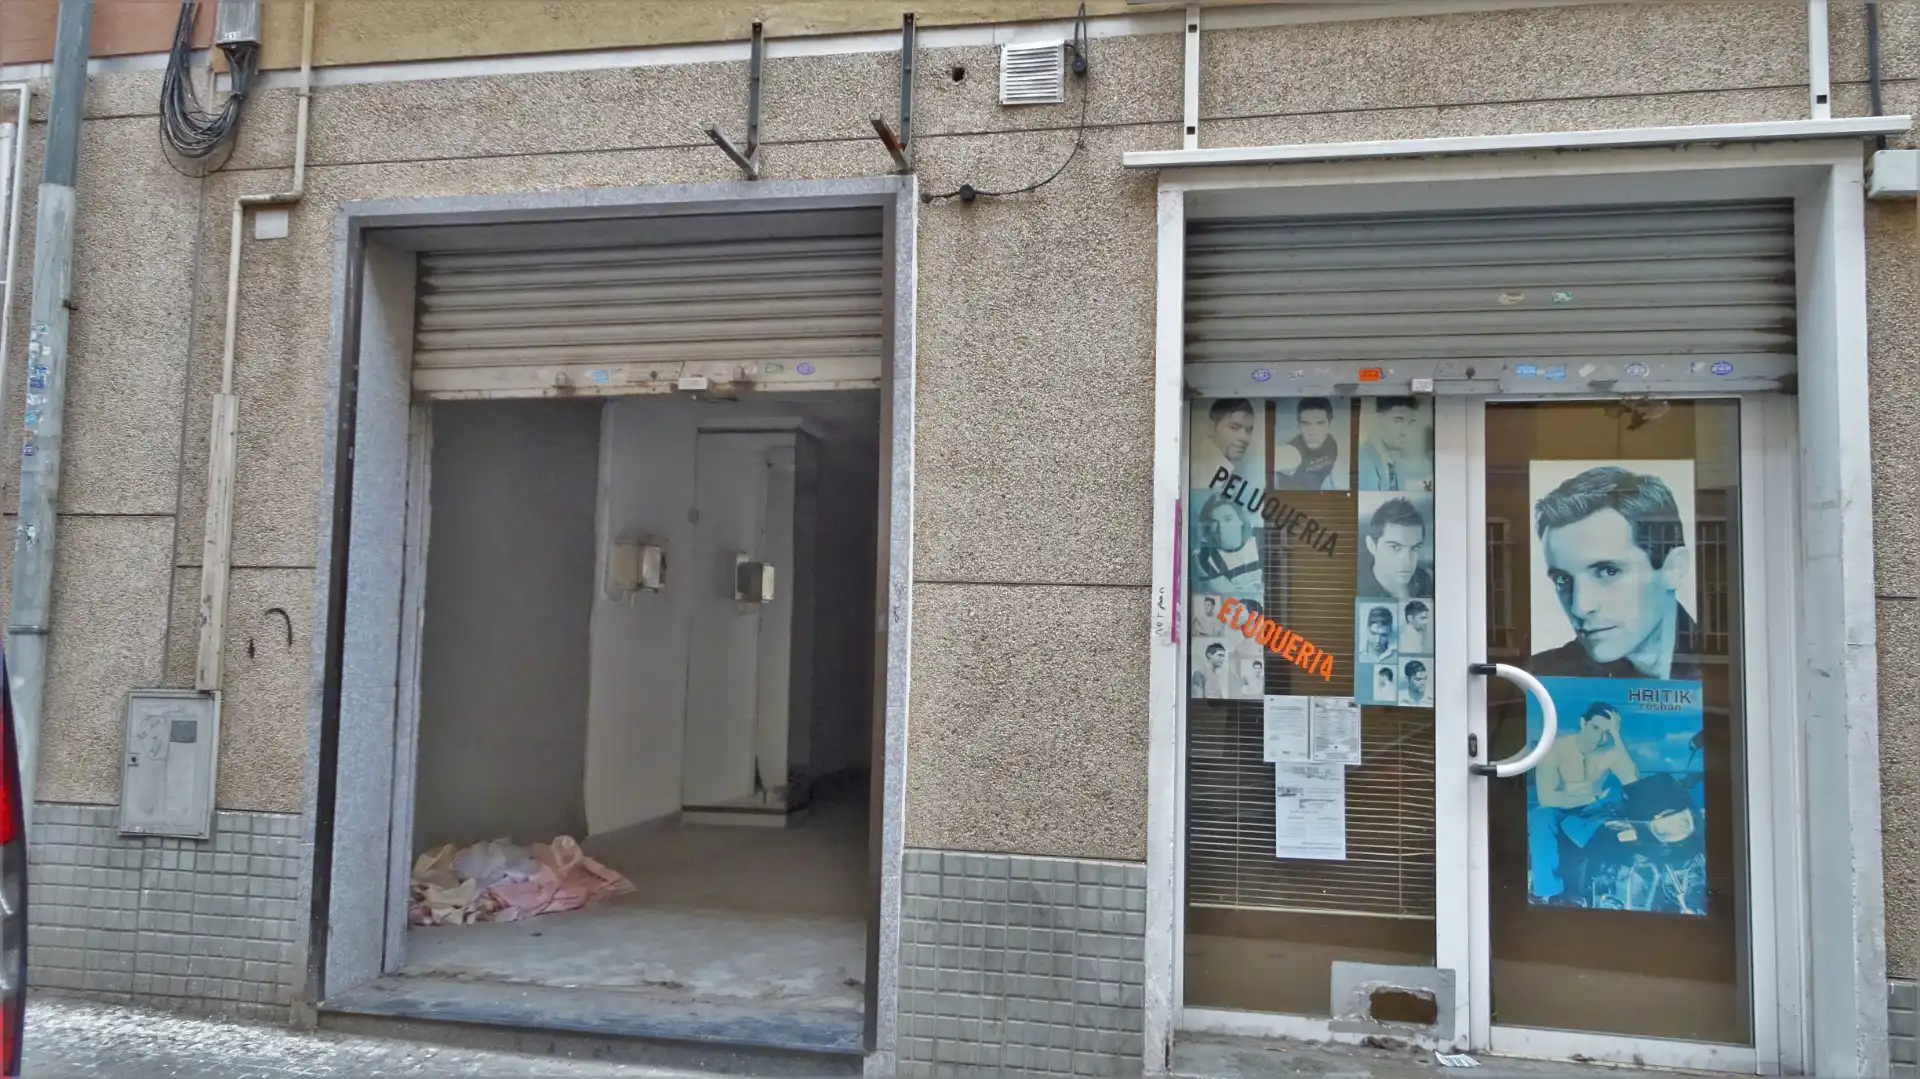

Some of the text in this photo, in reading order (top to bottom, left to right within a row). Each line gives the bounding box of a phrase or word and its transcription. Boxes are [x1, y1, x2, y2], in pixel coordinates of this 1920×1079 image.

[1208, 466, 1339, 558] PELUQUERIA
[1216, 596, 1335, 682] ELUQUERIA
[1628, 688, 1692, 704] HRITIK
[1640, 701, 1682, 712] roshan
